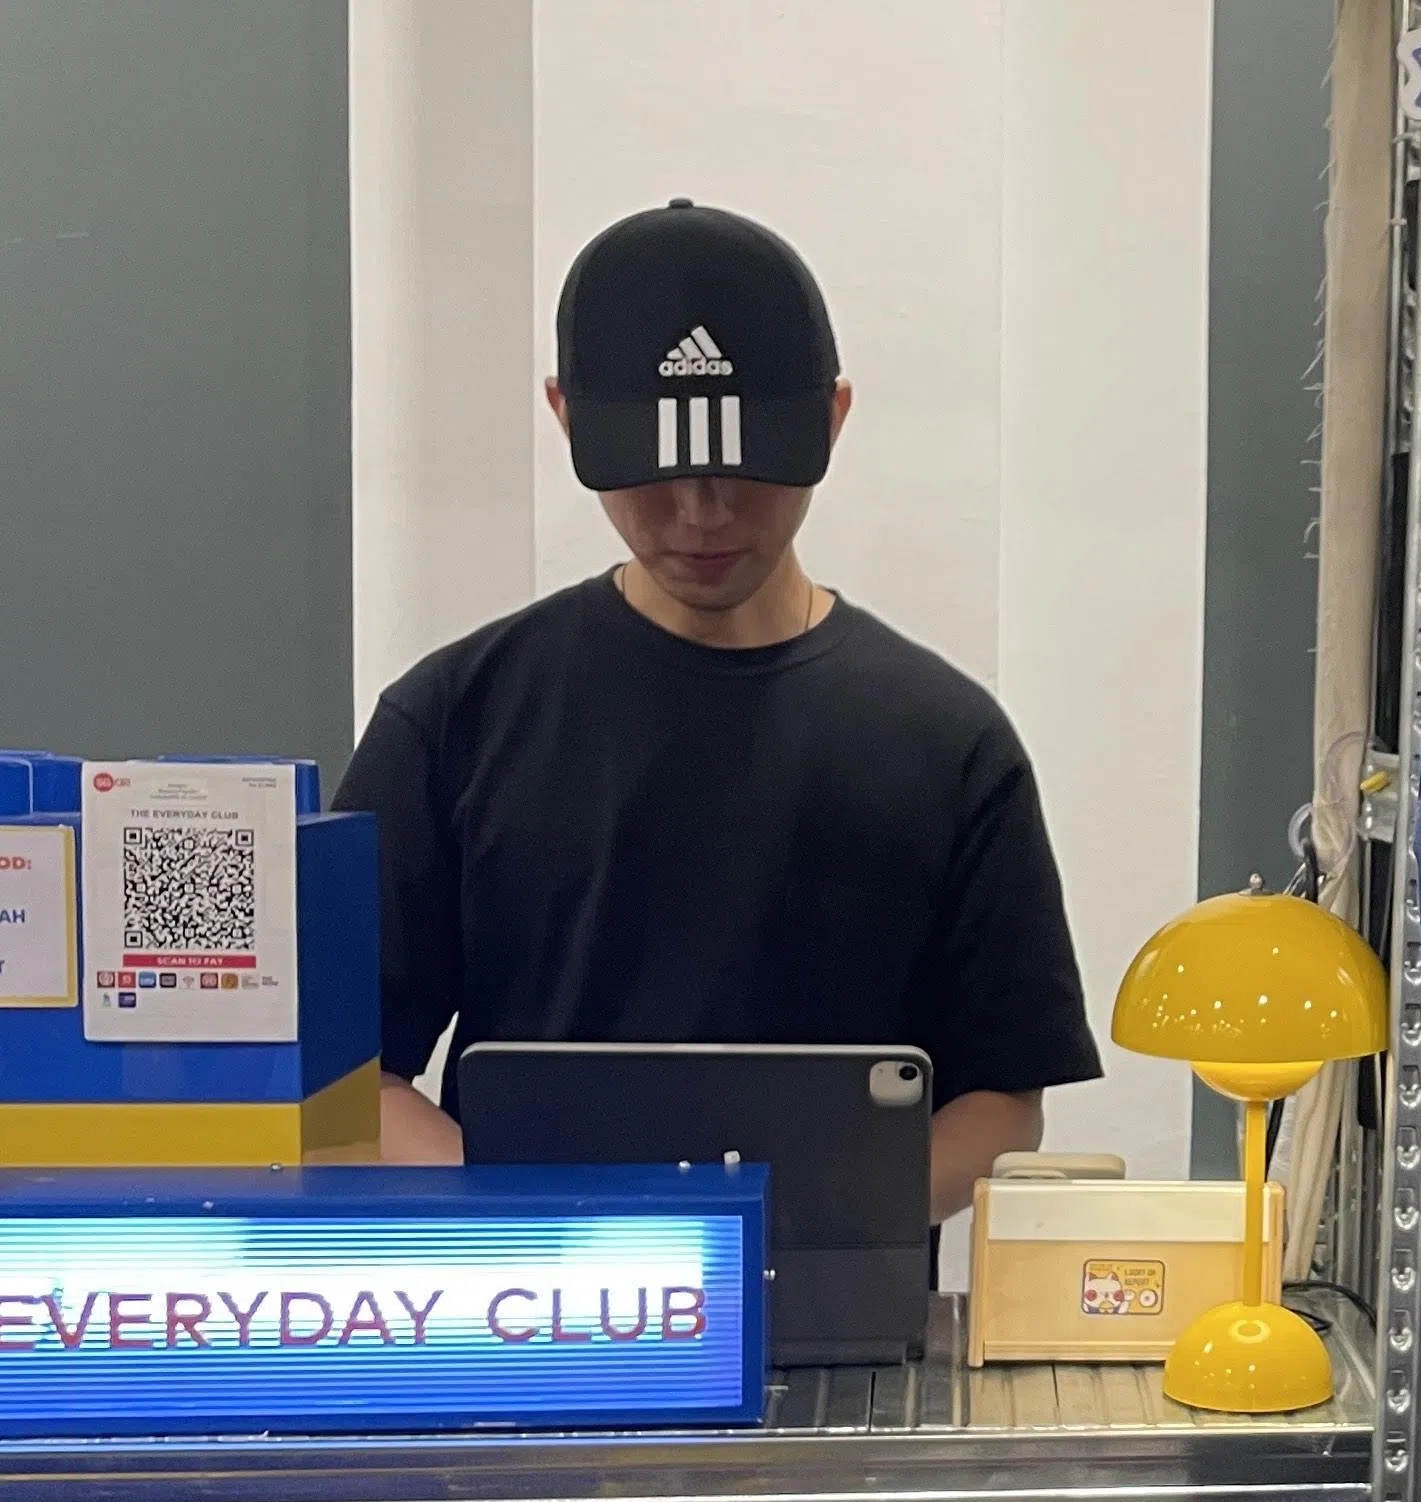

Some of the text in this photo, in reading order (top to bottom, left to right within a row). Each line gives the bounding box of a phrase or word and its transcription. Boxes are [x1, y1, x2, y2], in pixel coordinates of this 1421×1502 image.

[658, 358, 733, 377] adidas
[131, 809, 239, 820] THE EVERYDAY CLUB
[157, 956, 224, 966] SCAN TO PAY
[0, 1286, 708, 1350] EVERYDAY CLUB
